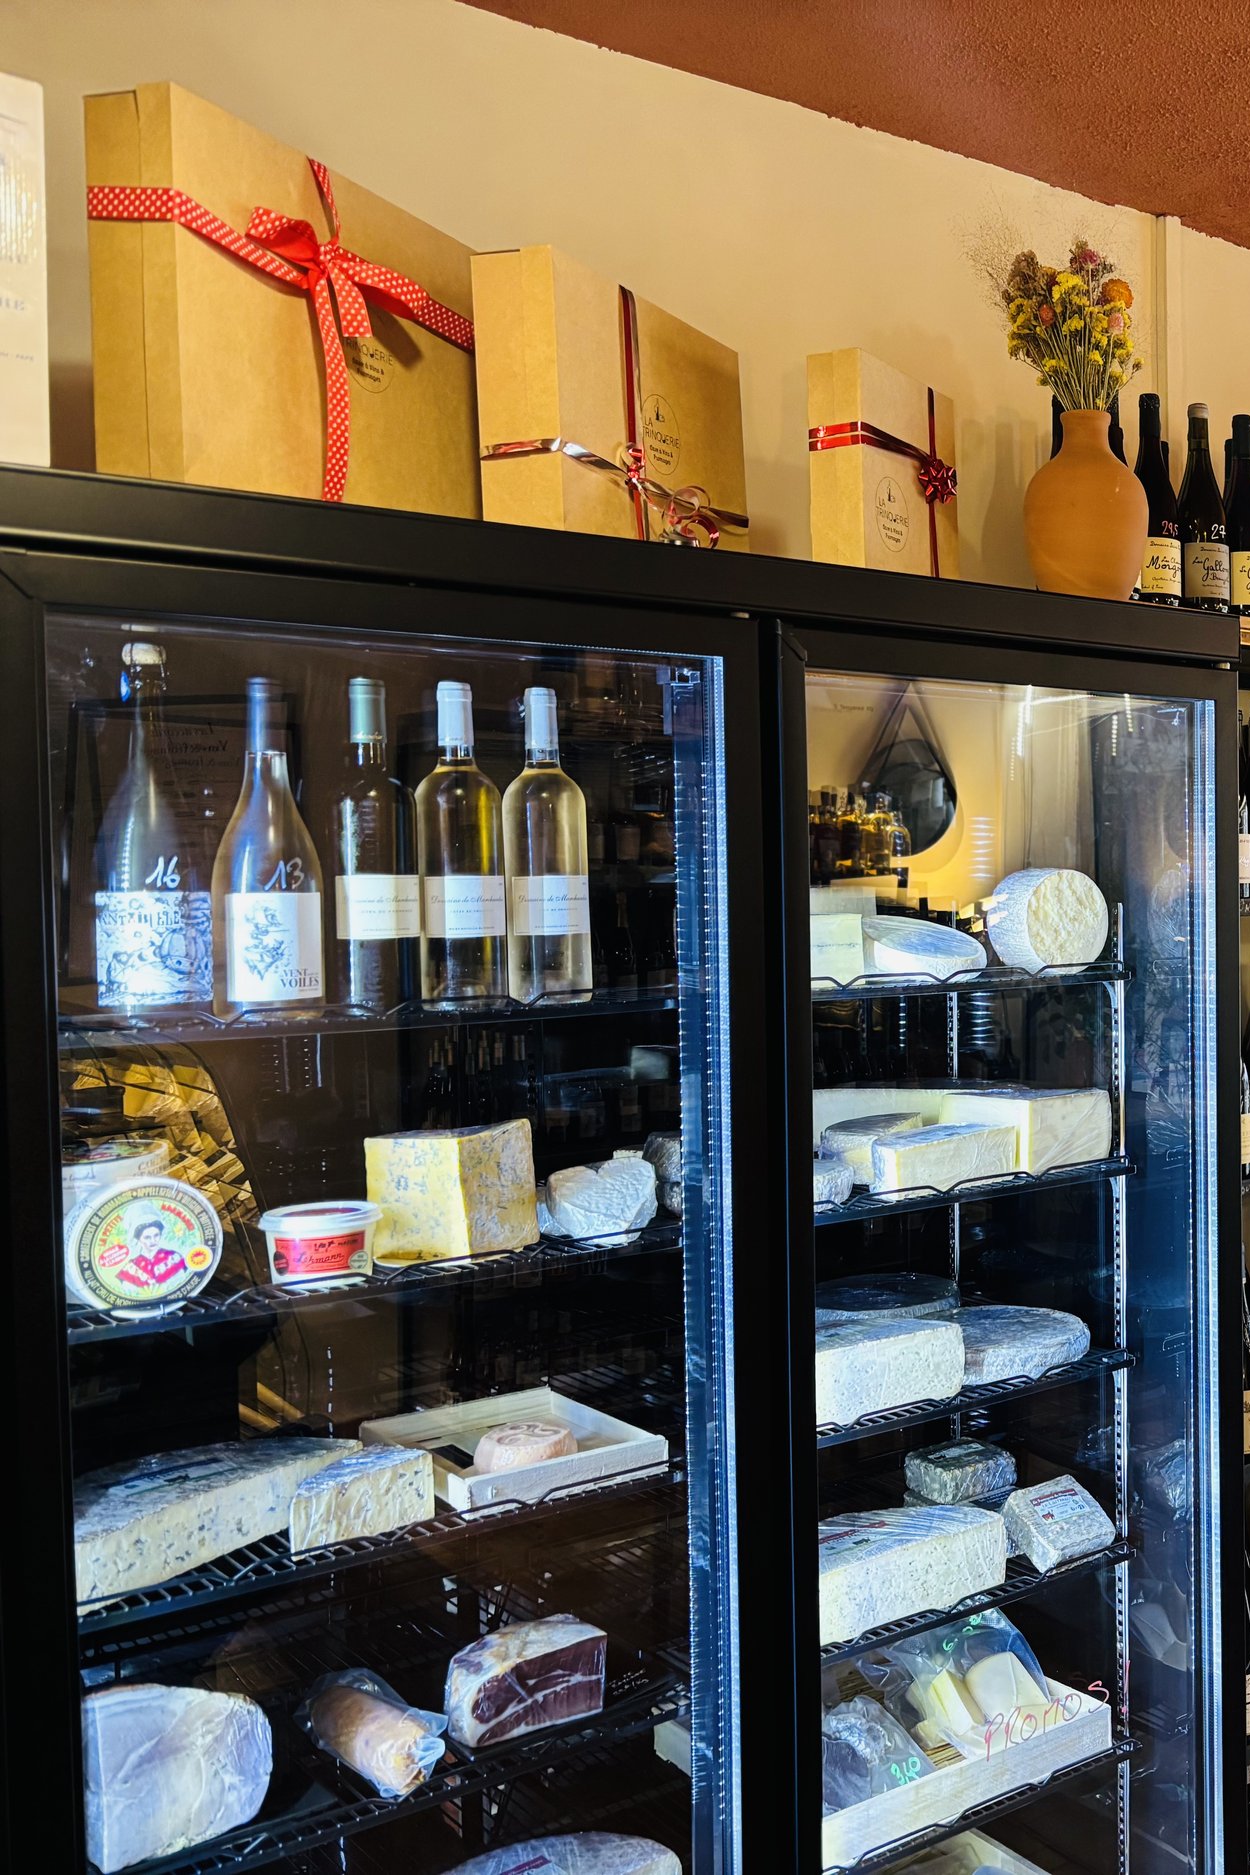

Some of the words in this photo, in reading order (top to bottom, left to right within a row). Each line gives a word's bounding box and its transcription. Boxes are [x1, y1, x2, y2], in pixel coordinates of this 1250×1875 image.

[644, 415, 653, 428] LA
[643, 426, 680, 449] TRINQUERIE
[1211, 524, 1226, 540] 27
[145, 855, 180, 889] 16
[264, 857, 305, 891] 13
[282, 968, 307, 977] VENT
[280, 977, 320, 989] VOILES
[92, 1213, 101, 1226] DE
[96, 1287, 109, 1301] CRU
[984, 1680, 1110, 1762] PROMOS
